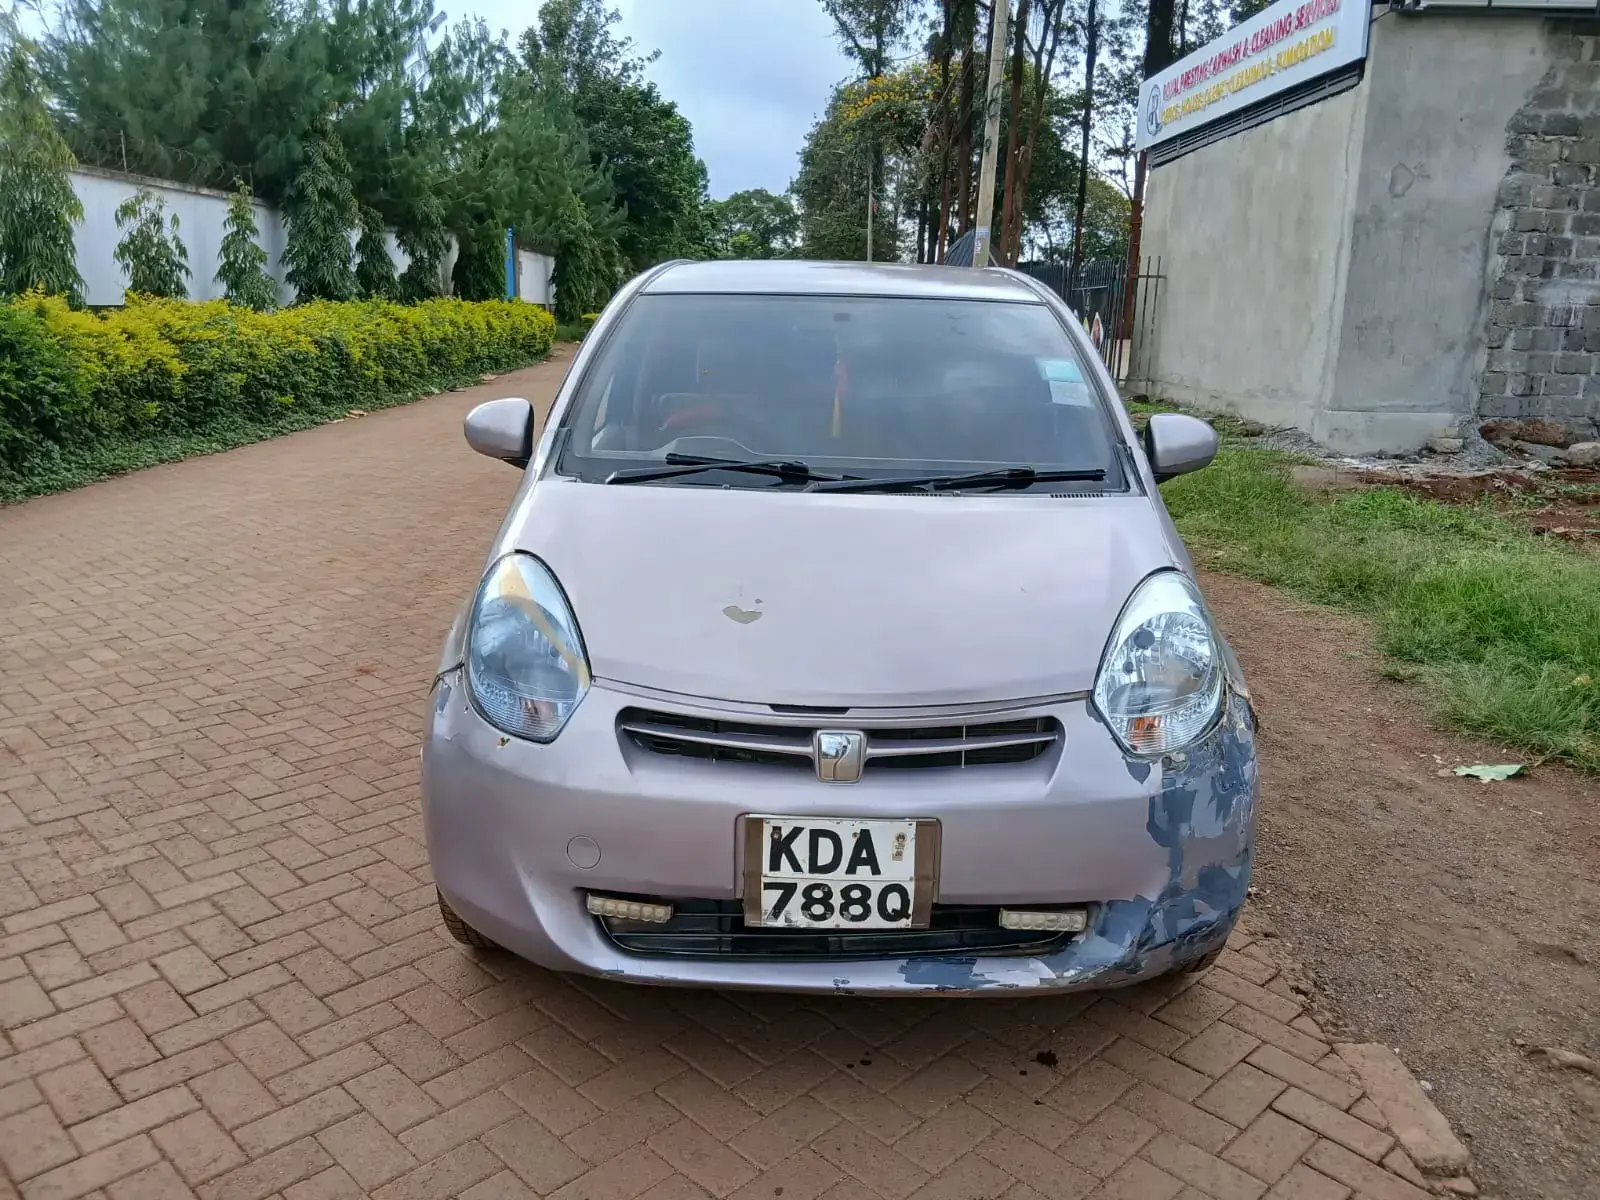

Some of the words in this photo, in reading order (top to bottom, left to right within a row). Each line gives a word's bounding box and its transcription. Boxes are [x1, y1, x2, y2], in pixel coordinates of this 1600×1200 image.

[1252, 12, 1292, 53] CLEANING
[769, 826, 881, 876] KDA
[763, 882, 911, 922] 788Q
